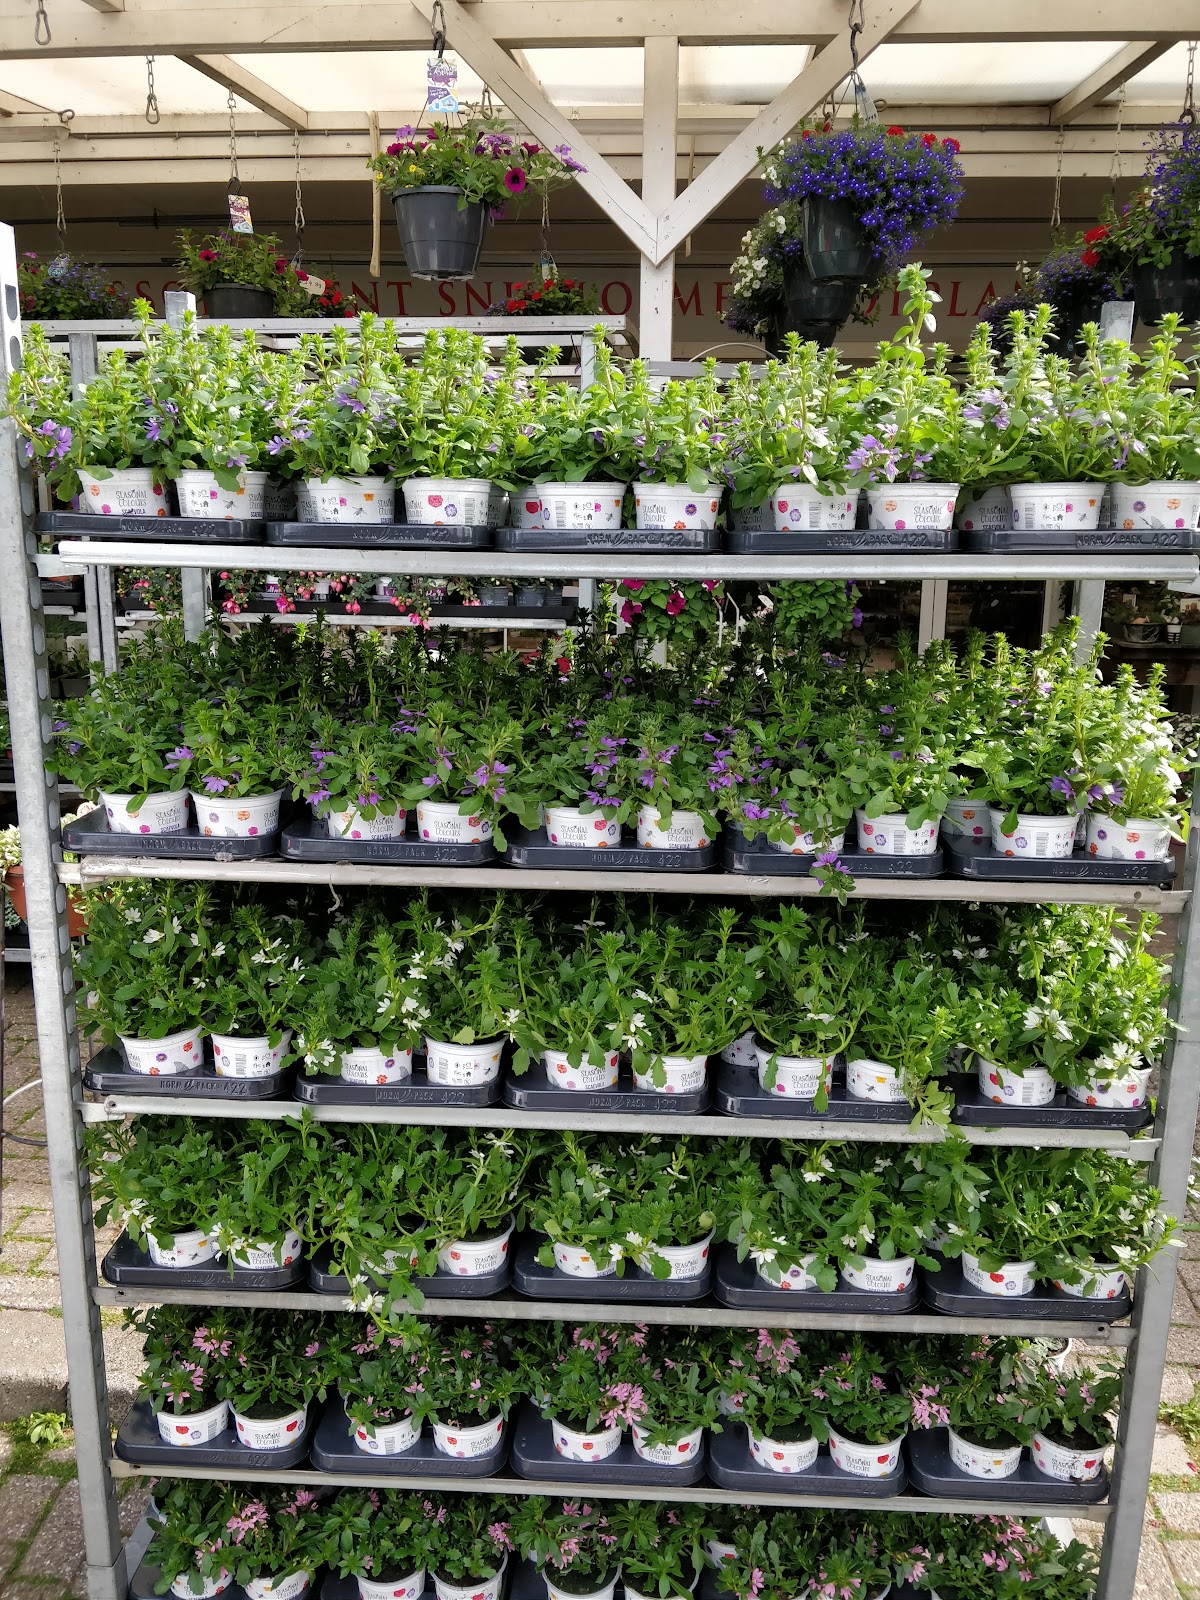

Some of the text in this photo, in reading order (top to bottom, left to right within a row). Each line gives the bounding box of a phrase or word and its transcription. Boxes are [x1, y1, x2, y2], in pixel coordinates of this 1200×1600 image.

[116, 490, 147, 499] SEASONAL
[118, 499, 147, 507] COLOURS
[642, 504, 667, 514] SEASONAL
[914, 505, 942, 515] SEASONAL
[915, 515, 940, 523] COLOURS
[1076, 534, 1103, 546] NORM
[1119, 534, 1142, 545] PACK
[370, 825, 394, 833] COLOURS
[434, 821, 462, 830] SEASONAL
[561, 825, 588, 833] SEASONAL
[436, 828, 460, 836] COLOURS
[563, 832, 586, 840] COLOURS
[583, 1075, 605, 1083] COLOURS
[160, 1080, 182, 1089] NORM
[414, 1092, 433, 1100] PACK
[442, 1092, 464, 1103] 422
[654, 1099, 676, 1111] 422
[675, 1260, 698, 1269] SEASONAL
[866, 1273, 892, 1281] SEASONAL
[649, 1452, 670, 1461] COLOURS
[846, 1455, 871, 1466] SEASONAL
[847, 1462, 870, 1471] COLOURS
